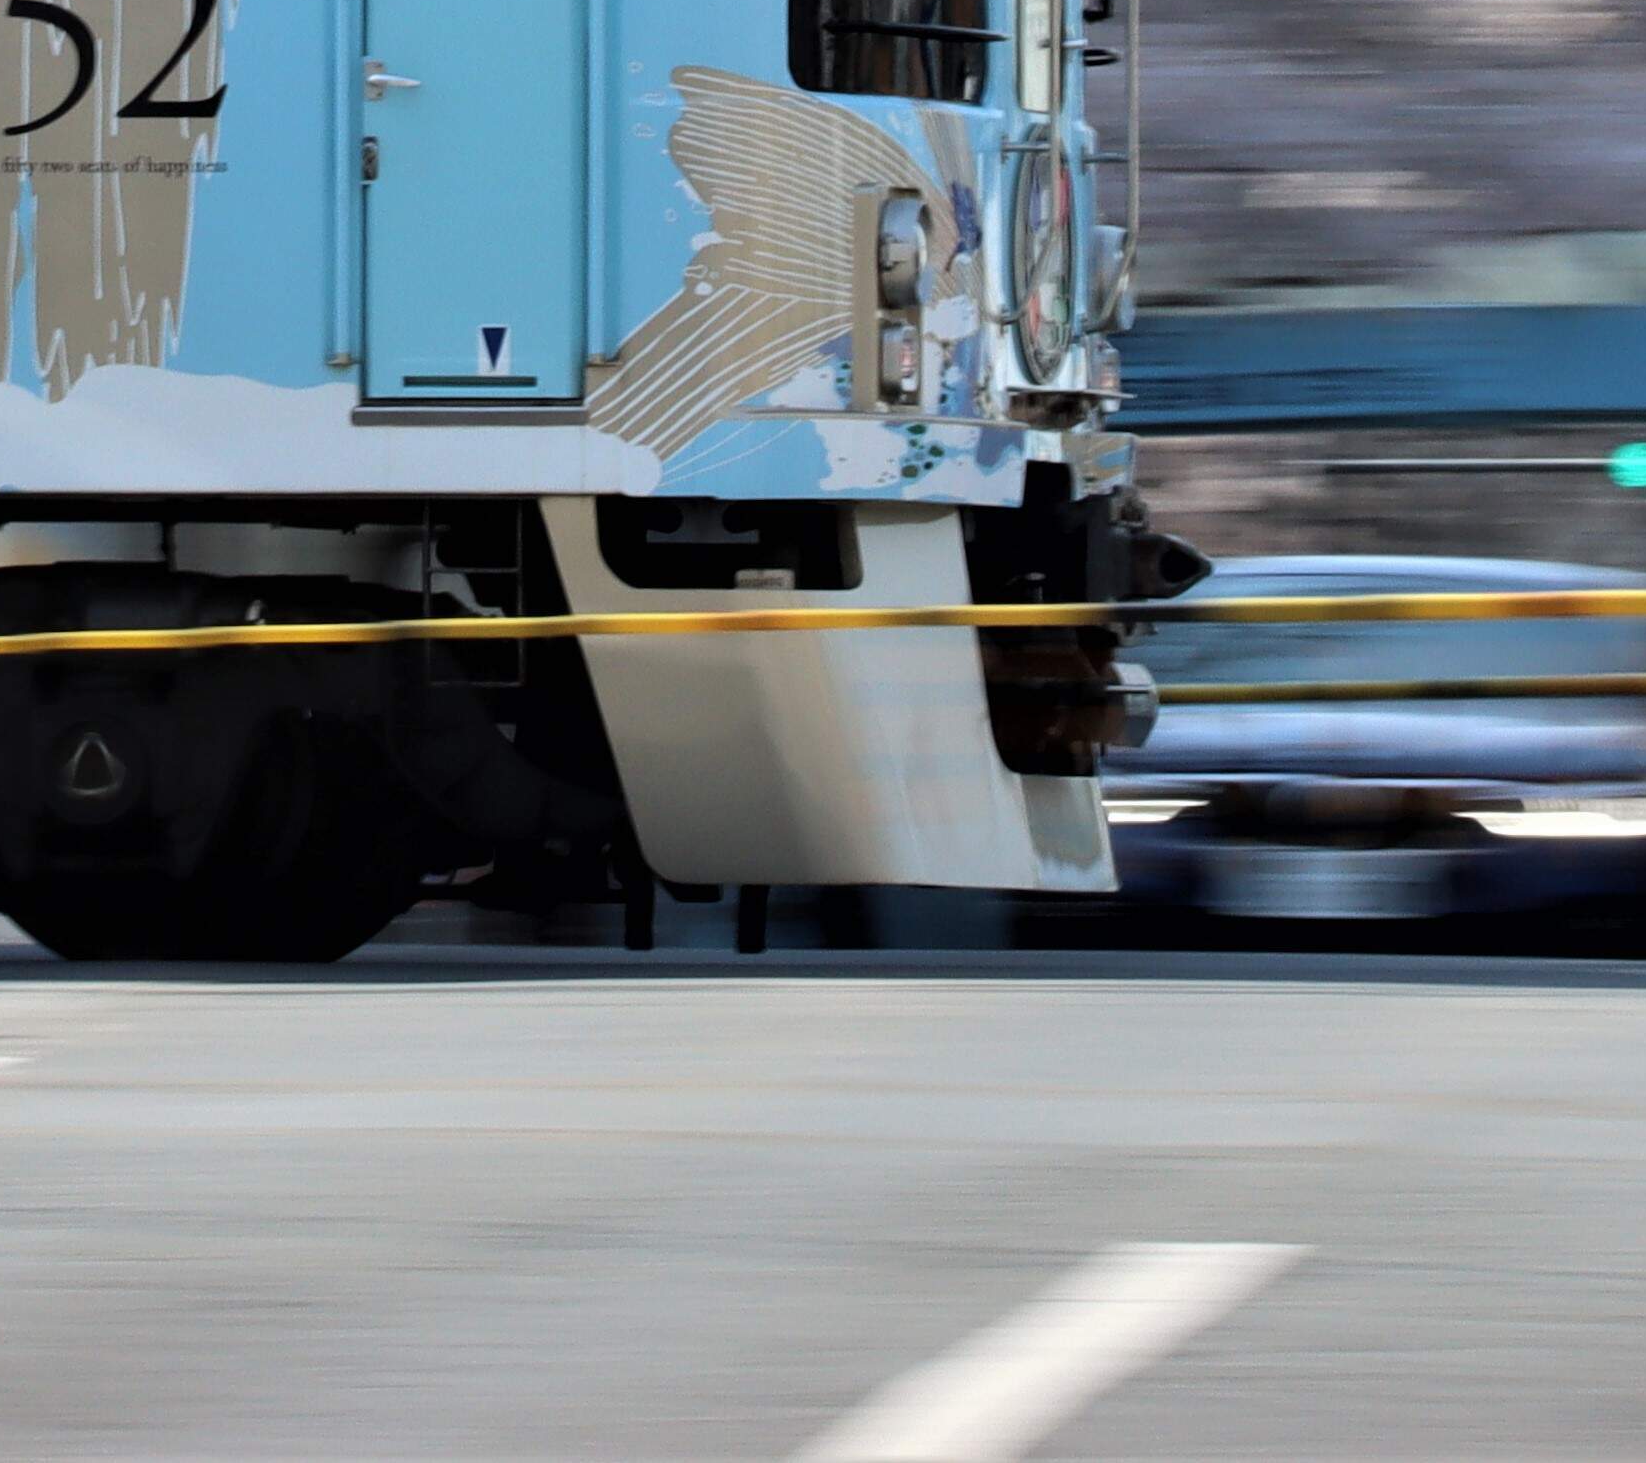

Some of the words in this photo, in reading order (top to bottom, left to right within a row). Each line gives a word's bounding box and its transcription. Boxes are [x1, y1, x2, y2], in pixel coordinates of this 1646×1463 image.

[42, 161, 73, 173] two
[124, 155, 145, 173] of
[147, 155, 228, 177] happness
